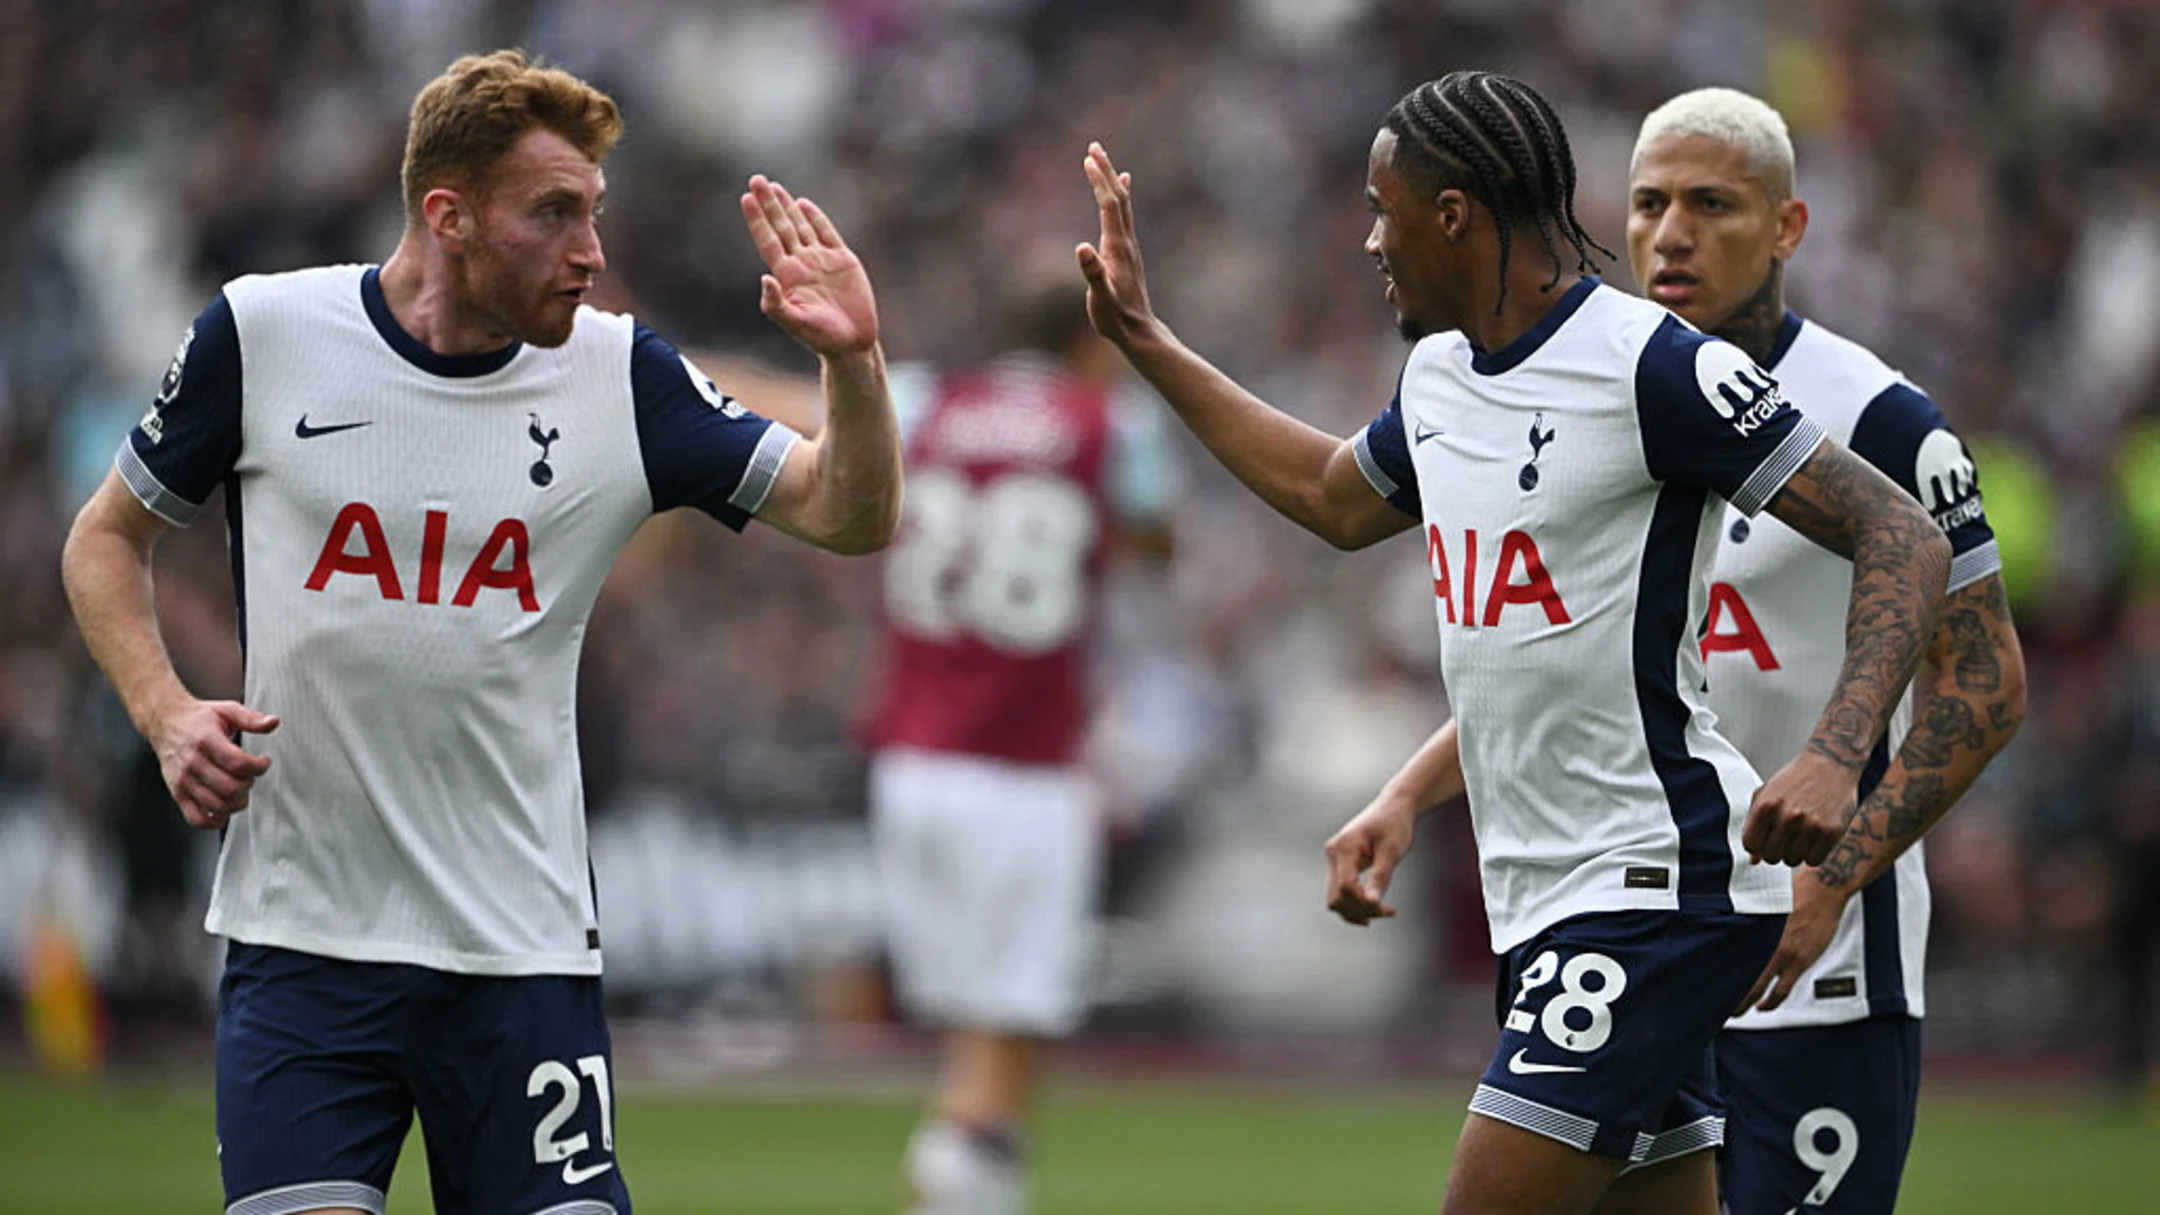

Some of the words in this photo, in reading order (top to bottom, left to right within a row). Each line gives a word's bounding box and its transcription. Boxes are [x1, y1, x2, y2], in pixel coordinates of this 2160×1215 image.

[1733, 387, 1782, 437] krake
[303, 501, 541, 613] AIA
[1428, 523, 1573, 627] AIA
[1505, 950, 1628, 1052] 28
[527, 1054, 612, 1164] 21
[1793, 1106, 1859, 1206] 9
